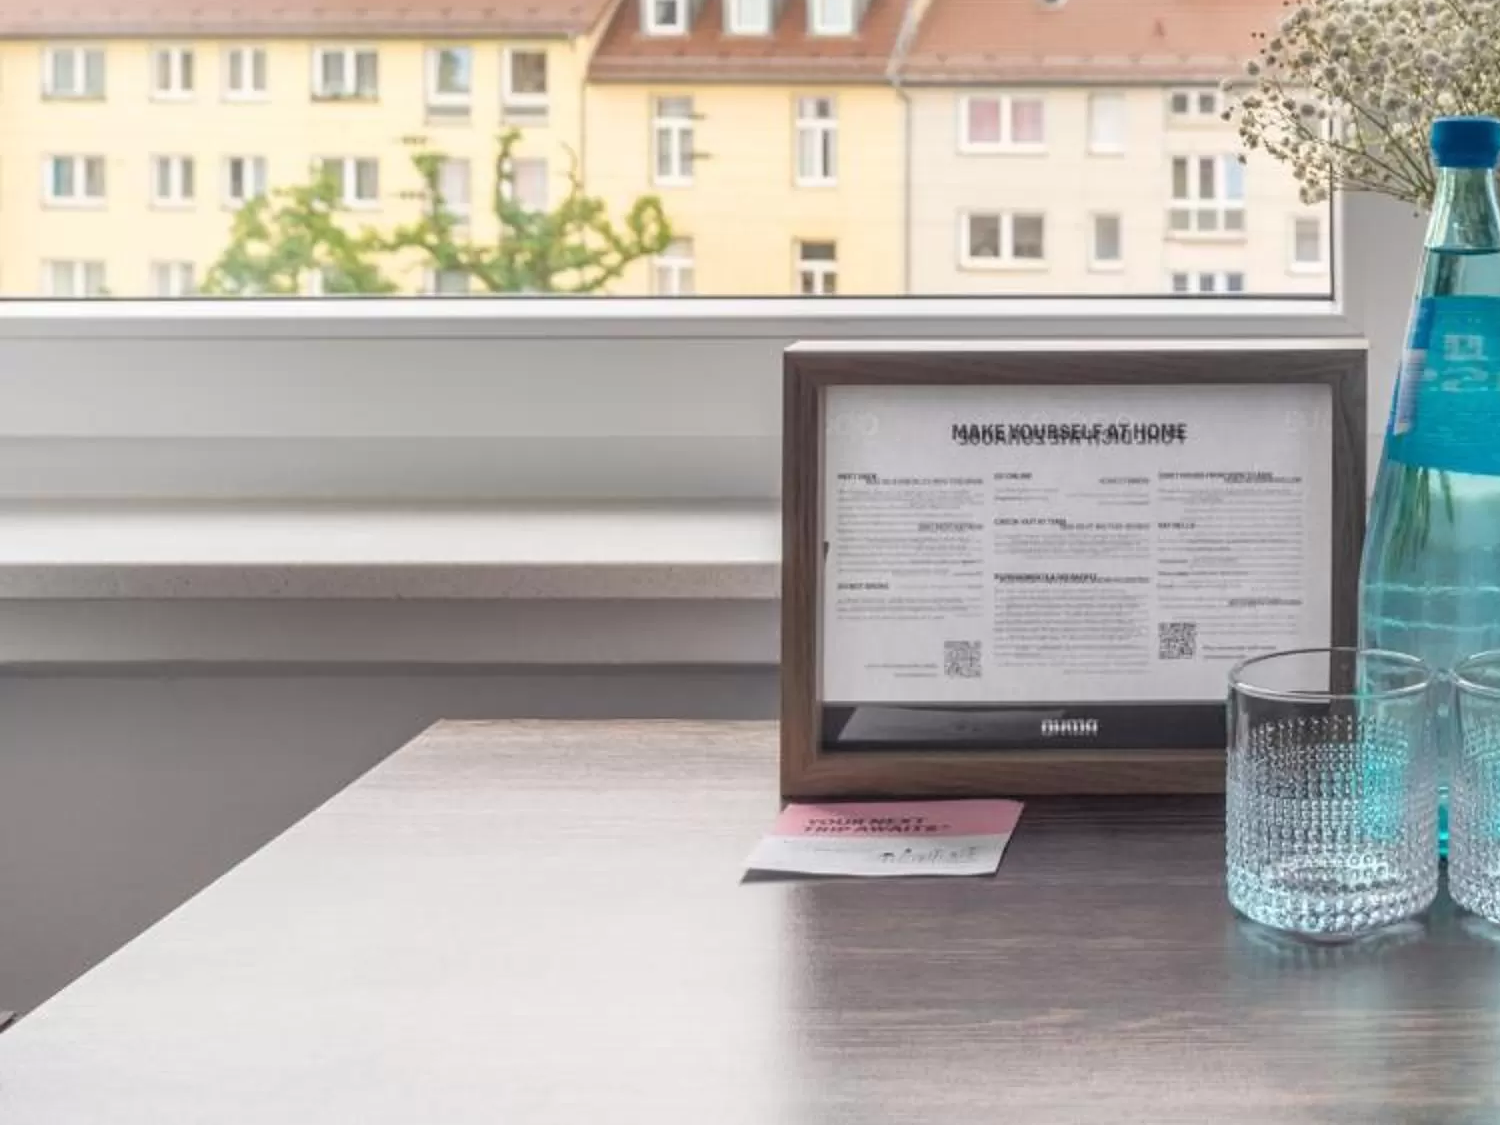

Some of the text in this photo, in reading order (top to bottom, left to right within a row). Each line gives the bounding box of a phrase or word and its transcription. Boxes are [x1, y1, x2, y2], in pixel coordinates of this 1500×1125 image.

[952, 423, 1187, 441] MAKE YOURSELF AT HOME
